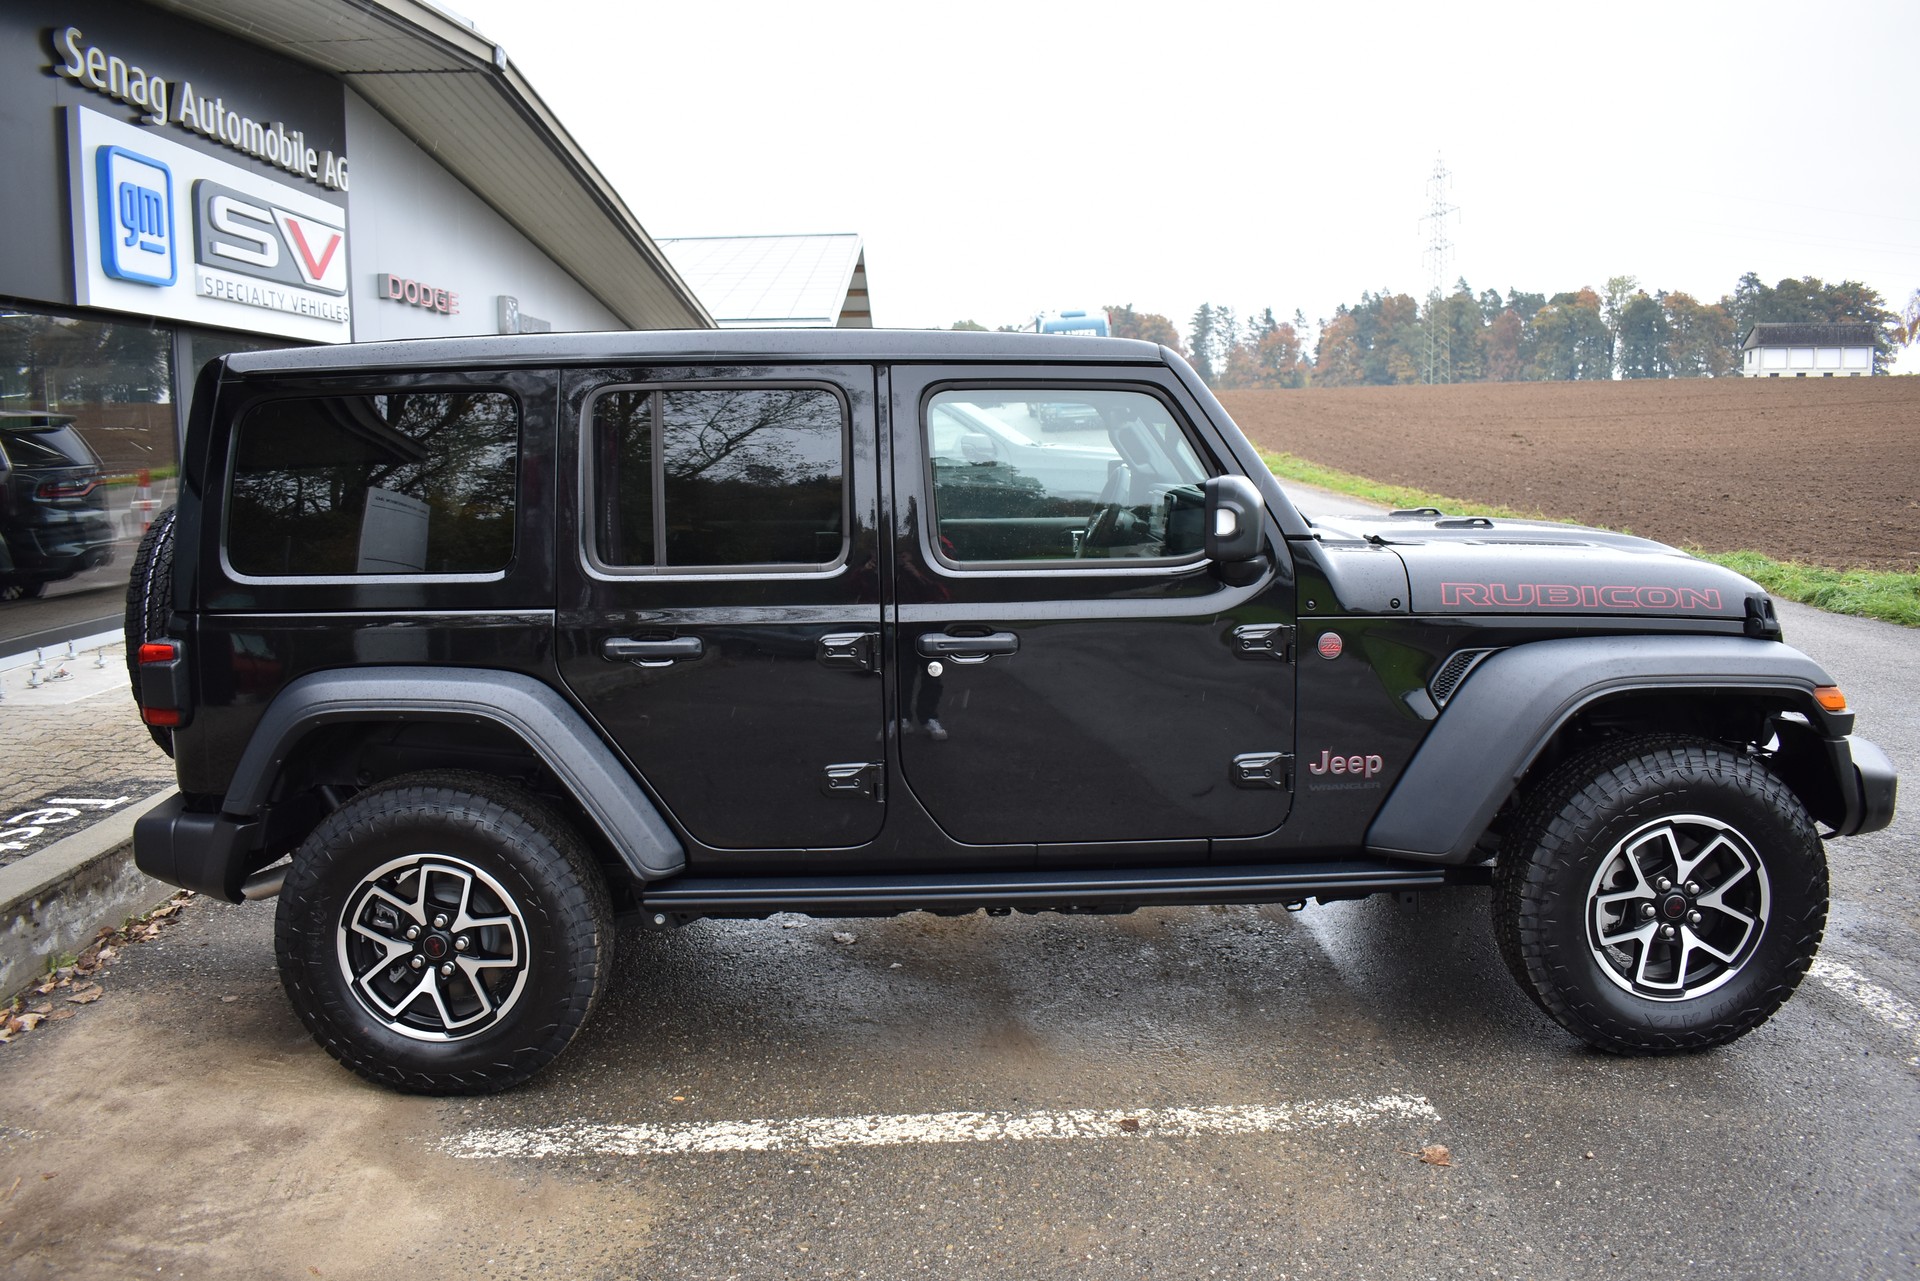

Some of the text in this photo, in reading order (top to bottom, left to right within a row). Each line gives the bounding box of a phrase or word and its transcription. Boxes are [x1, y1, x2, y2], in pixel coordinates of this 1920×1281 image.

[54, 26, 349, 192] Senag Automobile AG
[119, 181, 166, 248] gm
[208, 194, 342, 281] SV
[204, 276, 350, 322] SPECIALTY VEHICLES
[379, 273, 460, 315] DODGE
[1440, 582, 1723, 610] RUBICON
[1308, 750, 1384, 779] Jeep
[1308, 781, 1382, 792] WRANGLER
